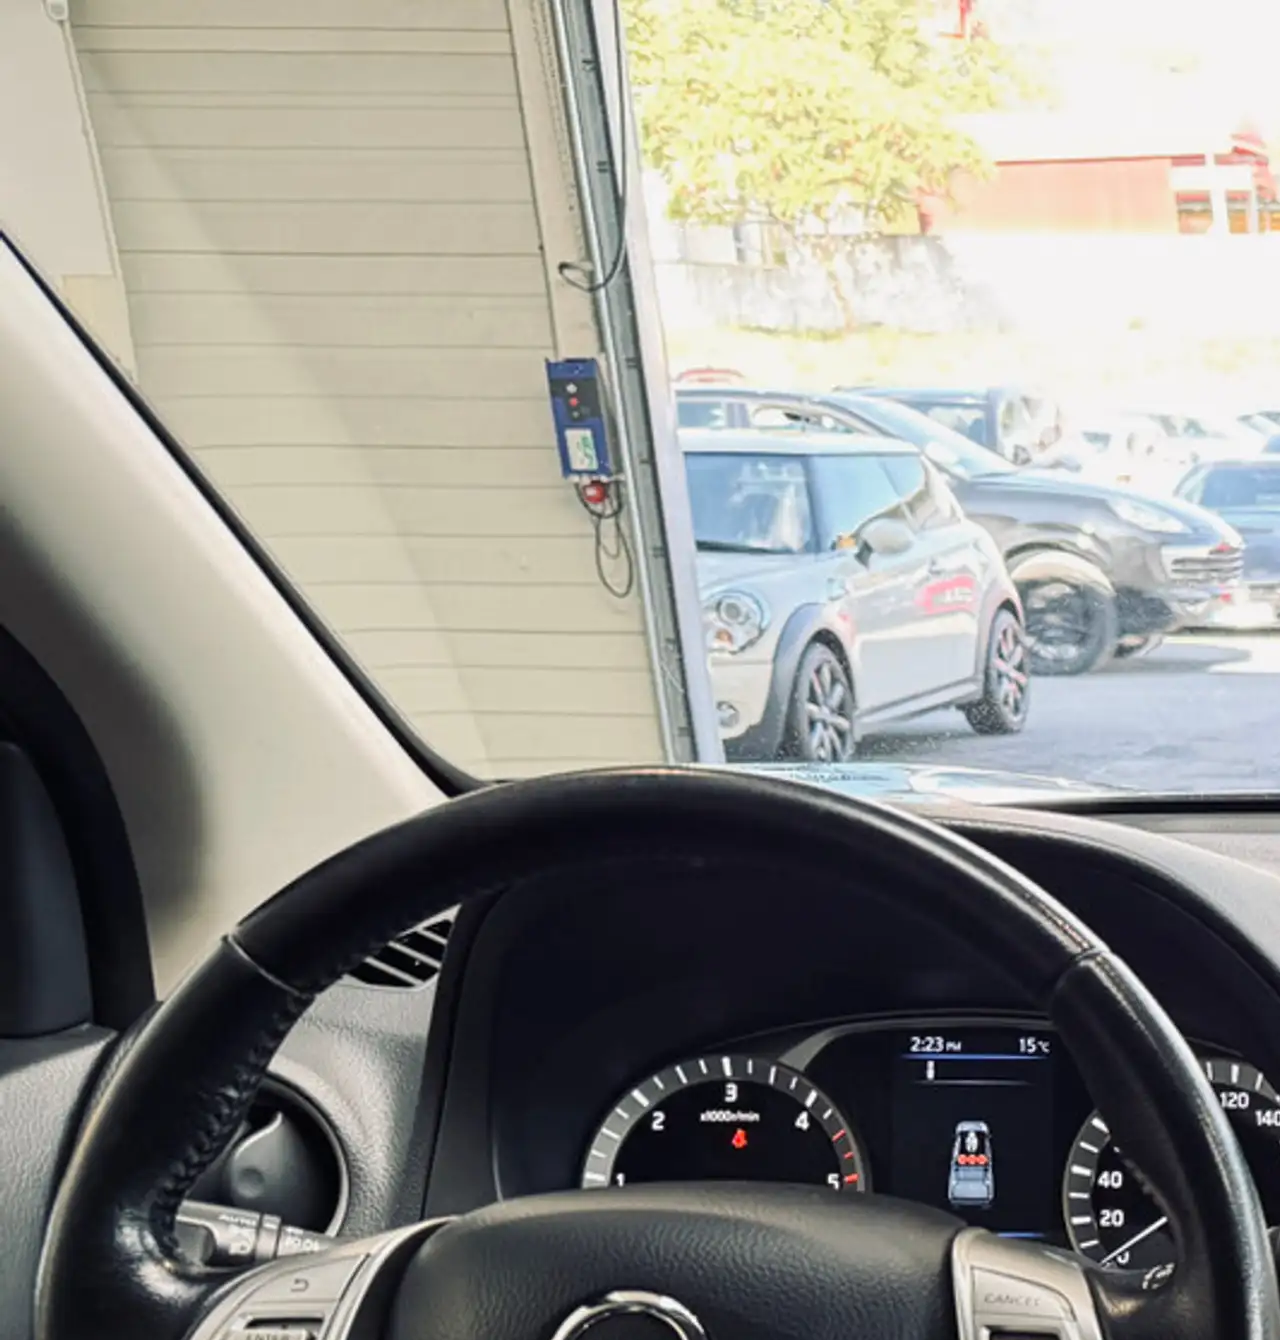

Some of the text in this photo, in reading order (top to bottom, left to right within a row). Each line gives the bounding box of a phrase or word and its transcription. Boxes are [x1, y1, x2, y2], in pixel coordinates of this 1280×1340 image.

[910, 1036, 944, 1052] 2:23
[725, 1083, 738, 1102] 3
[1220, 1092, 1249, 1109] 120
[652, 1111, 665, 1131] 2
[795, 1112, 809, 1131] 4
[1098, 1171, 1122, 1188] 40
[1100, 1209, 1124, 1228] 20
[984, 1292, 1041, 1307] CANCEL
